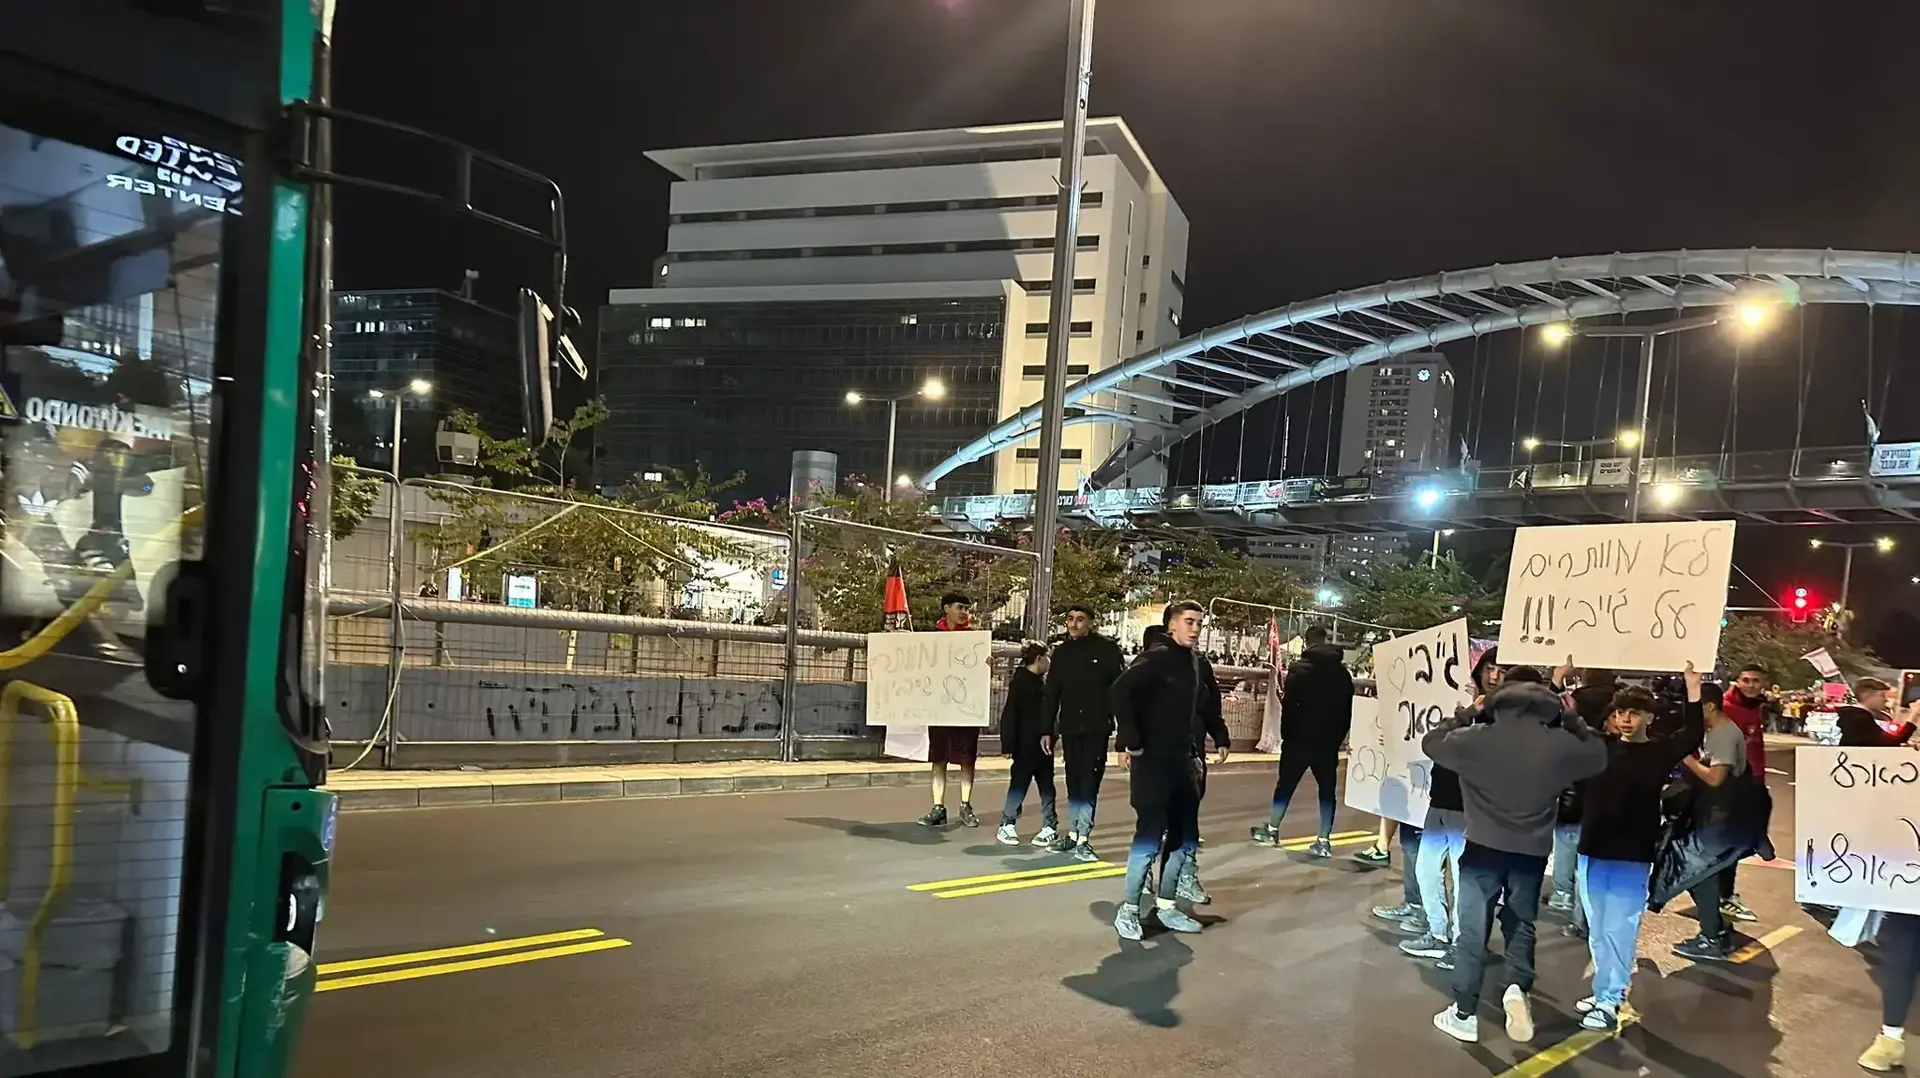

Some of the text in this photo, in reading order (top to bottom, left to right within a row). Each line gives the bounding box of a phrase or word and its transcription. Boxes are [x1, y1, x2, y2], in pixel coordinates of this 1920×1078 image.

[1518, 528, 1722, 584] לא מוותרים
[1650, 589, 1696, 640] על
